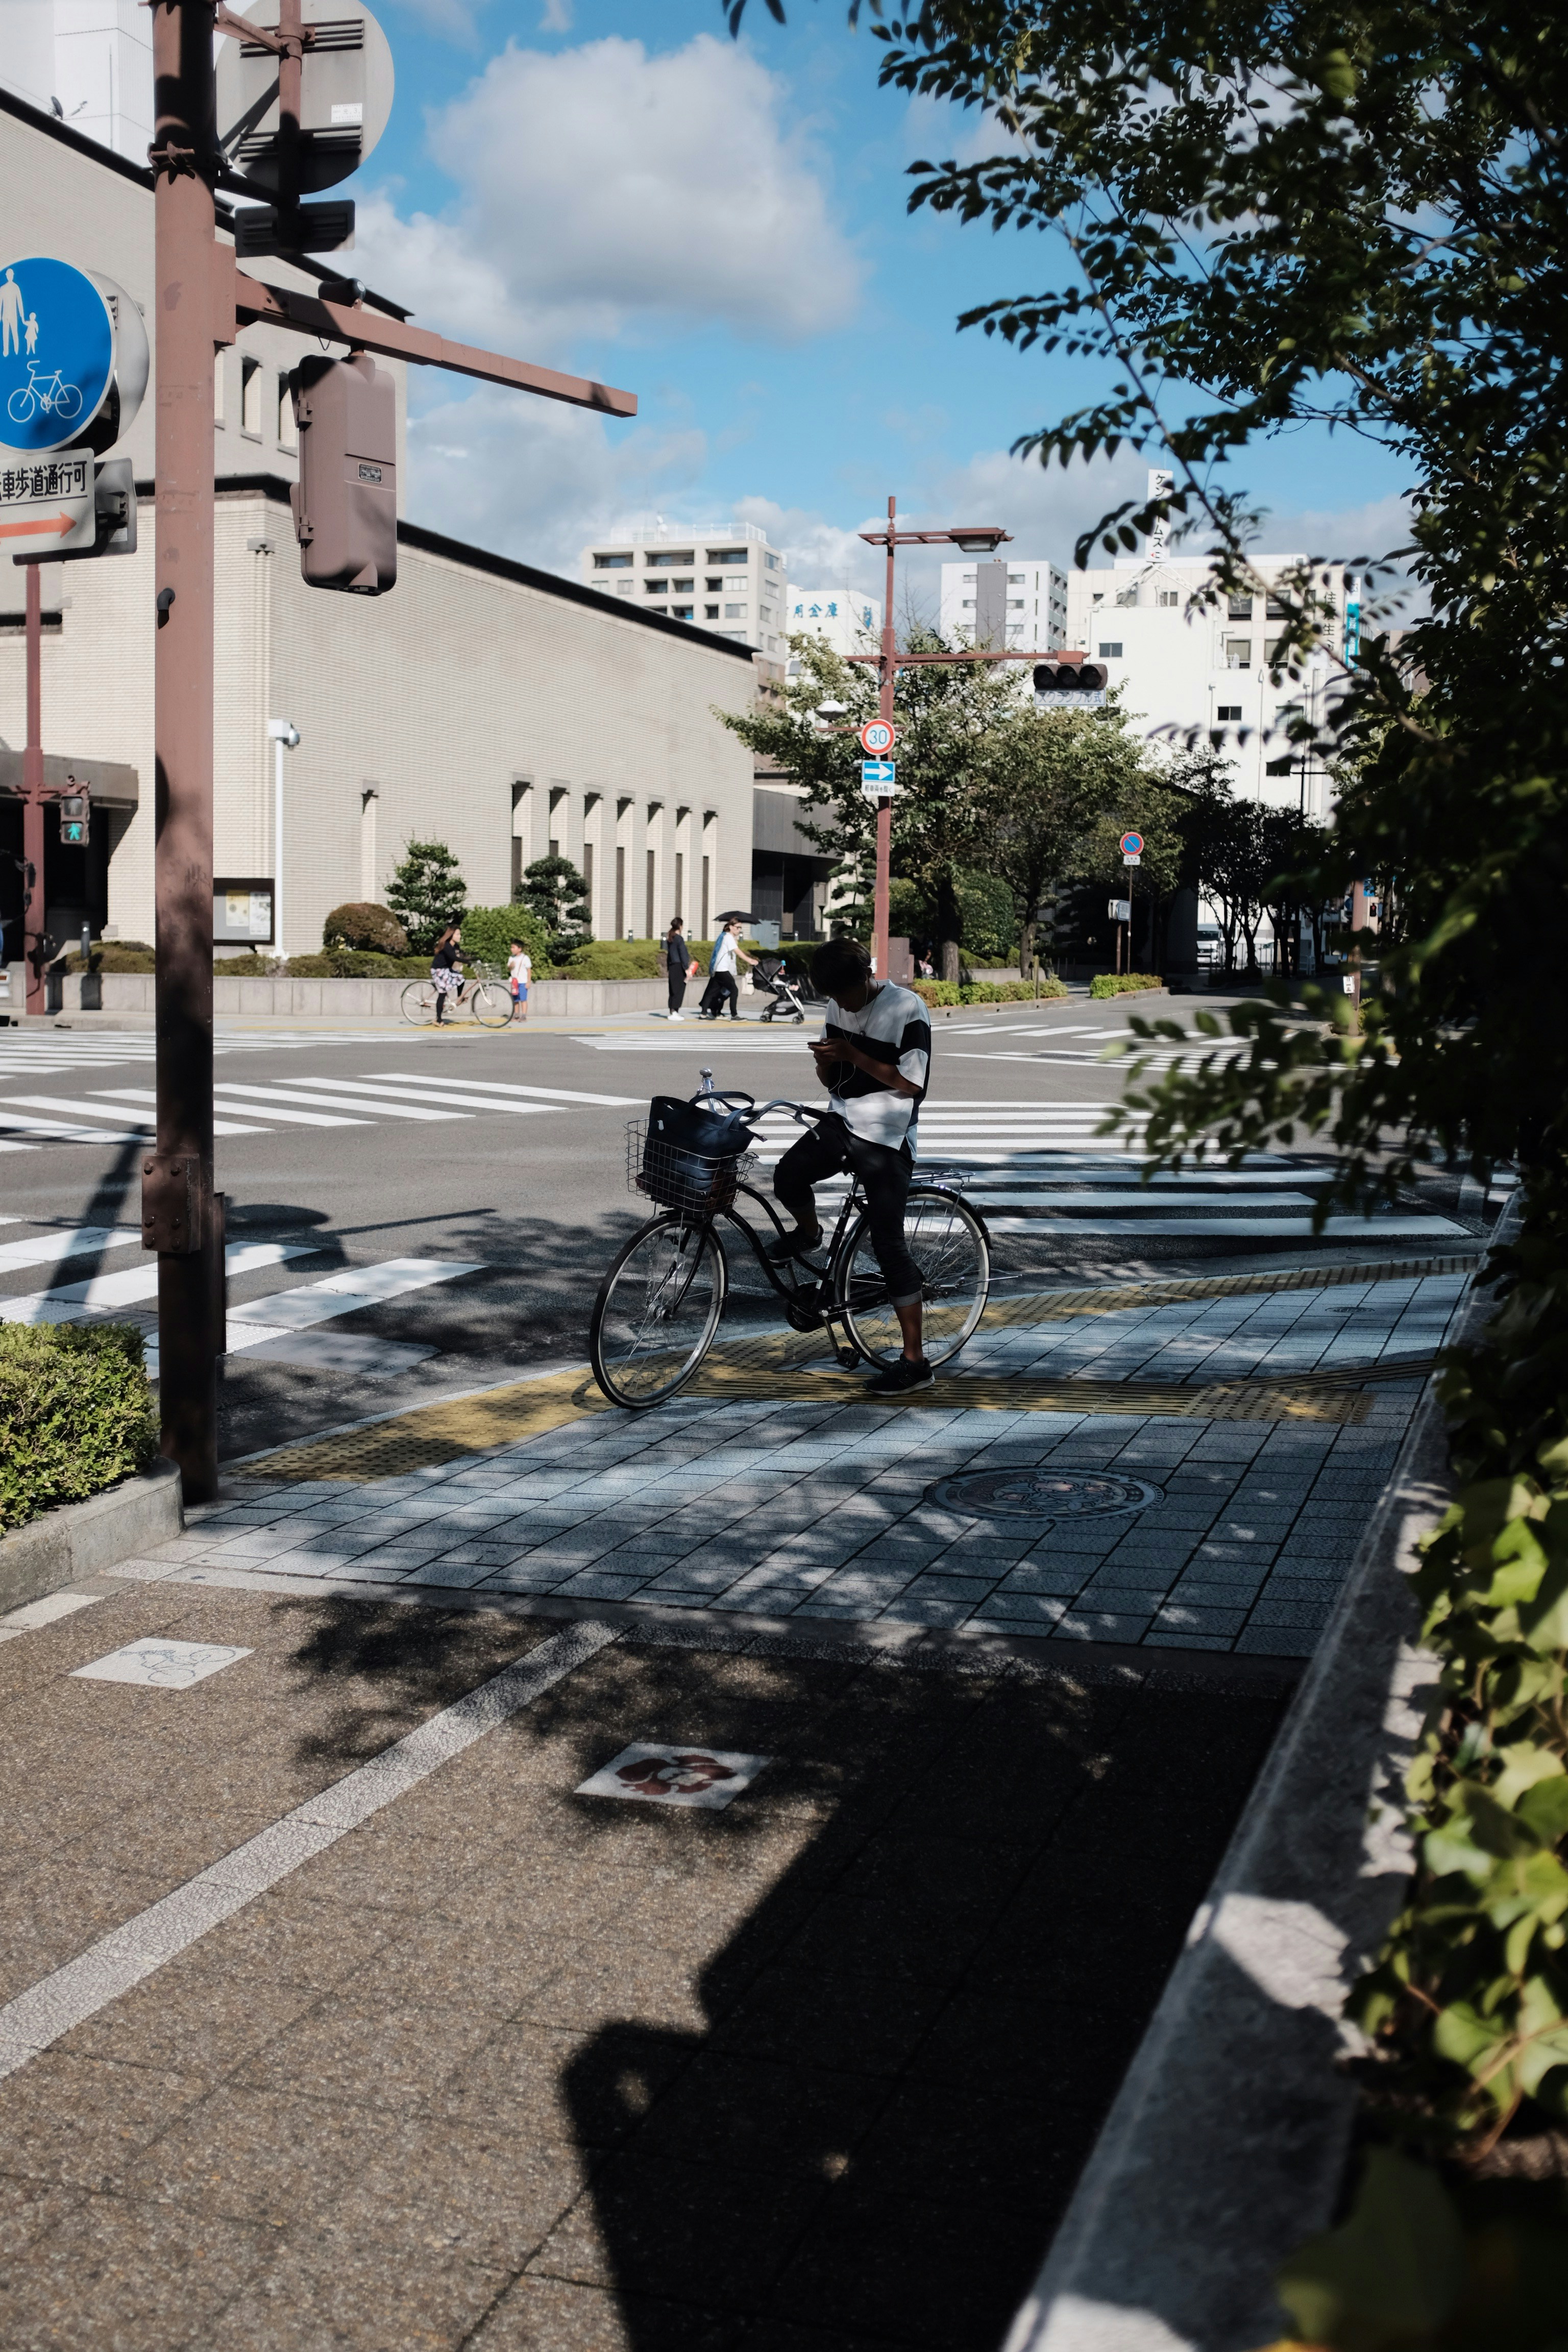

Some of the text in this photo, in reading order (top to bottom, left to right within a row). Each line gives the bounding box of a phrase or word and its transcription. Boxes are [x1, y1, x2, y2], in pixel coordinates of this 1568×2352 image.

[0, 460, 87, 501] 車歩道通行可
[1153, 474, 1165, 548] ケンームズ
[787, 602, 838, 619] 用金庫
[1324, 592, 1336, 651] 住生
[869, 730, 887, 744] 30
